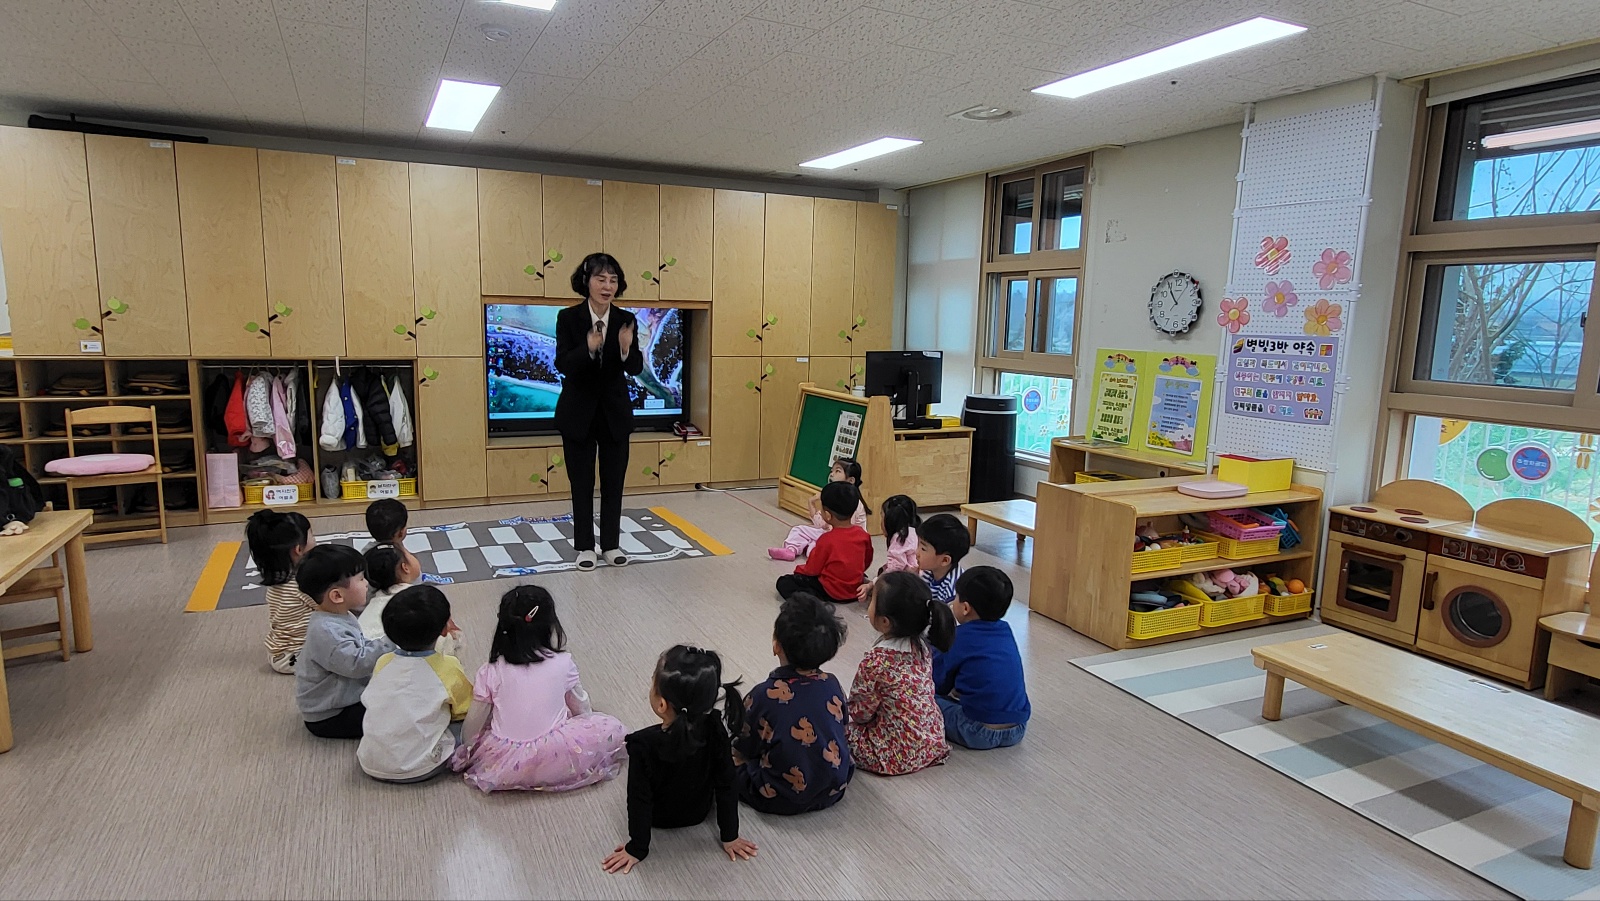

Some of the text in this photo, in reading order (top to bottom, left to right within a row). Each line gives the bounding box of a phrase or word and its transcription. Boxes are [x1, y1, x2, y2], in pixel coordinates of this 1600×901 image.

[1175, 279, 1183, 287] 12
[1161, 290, 1168, 298] 10
[1157, 300, 1164, 308] 9
[1160, 310, 1165, 318] 8
[1172, 320, 1179, 329] 6
[1181, 317, 1188, 326] 5
[1246, 338, 1315, 356] 별빛3반 약속
